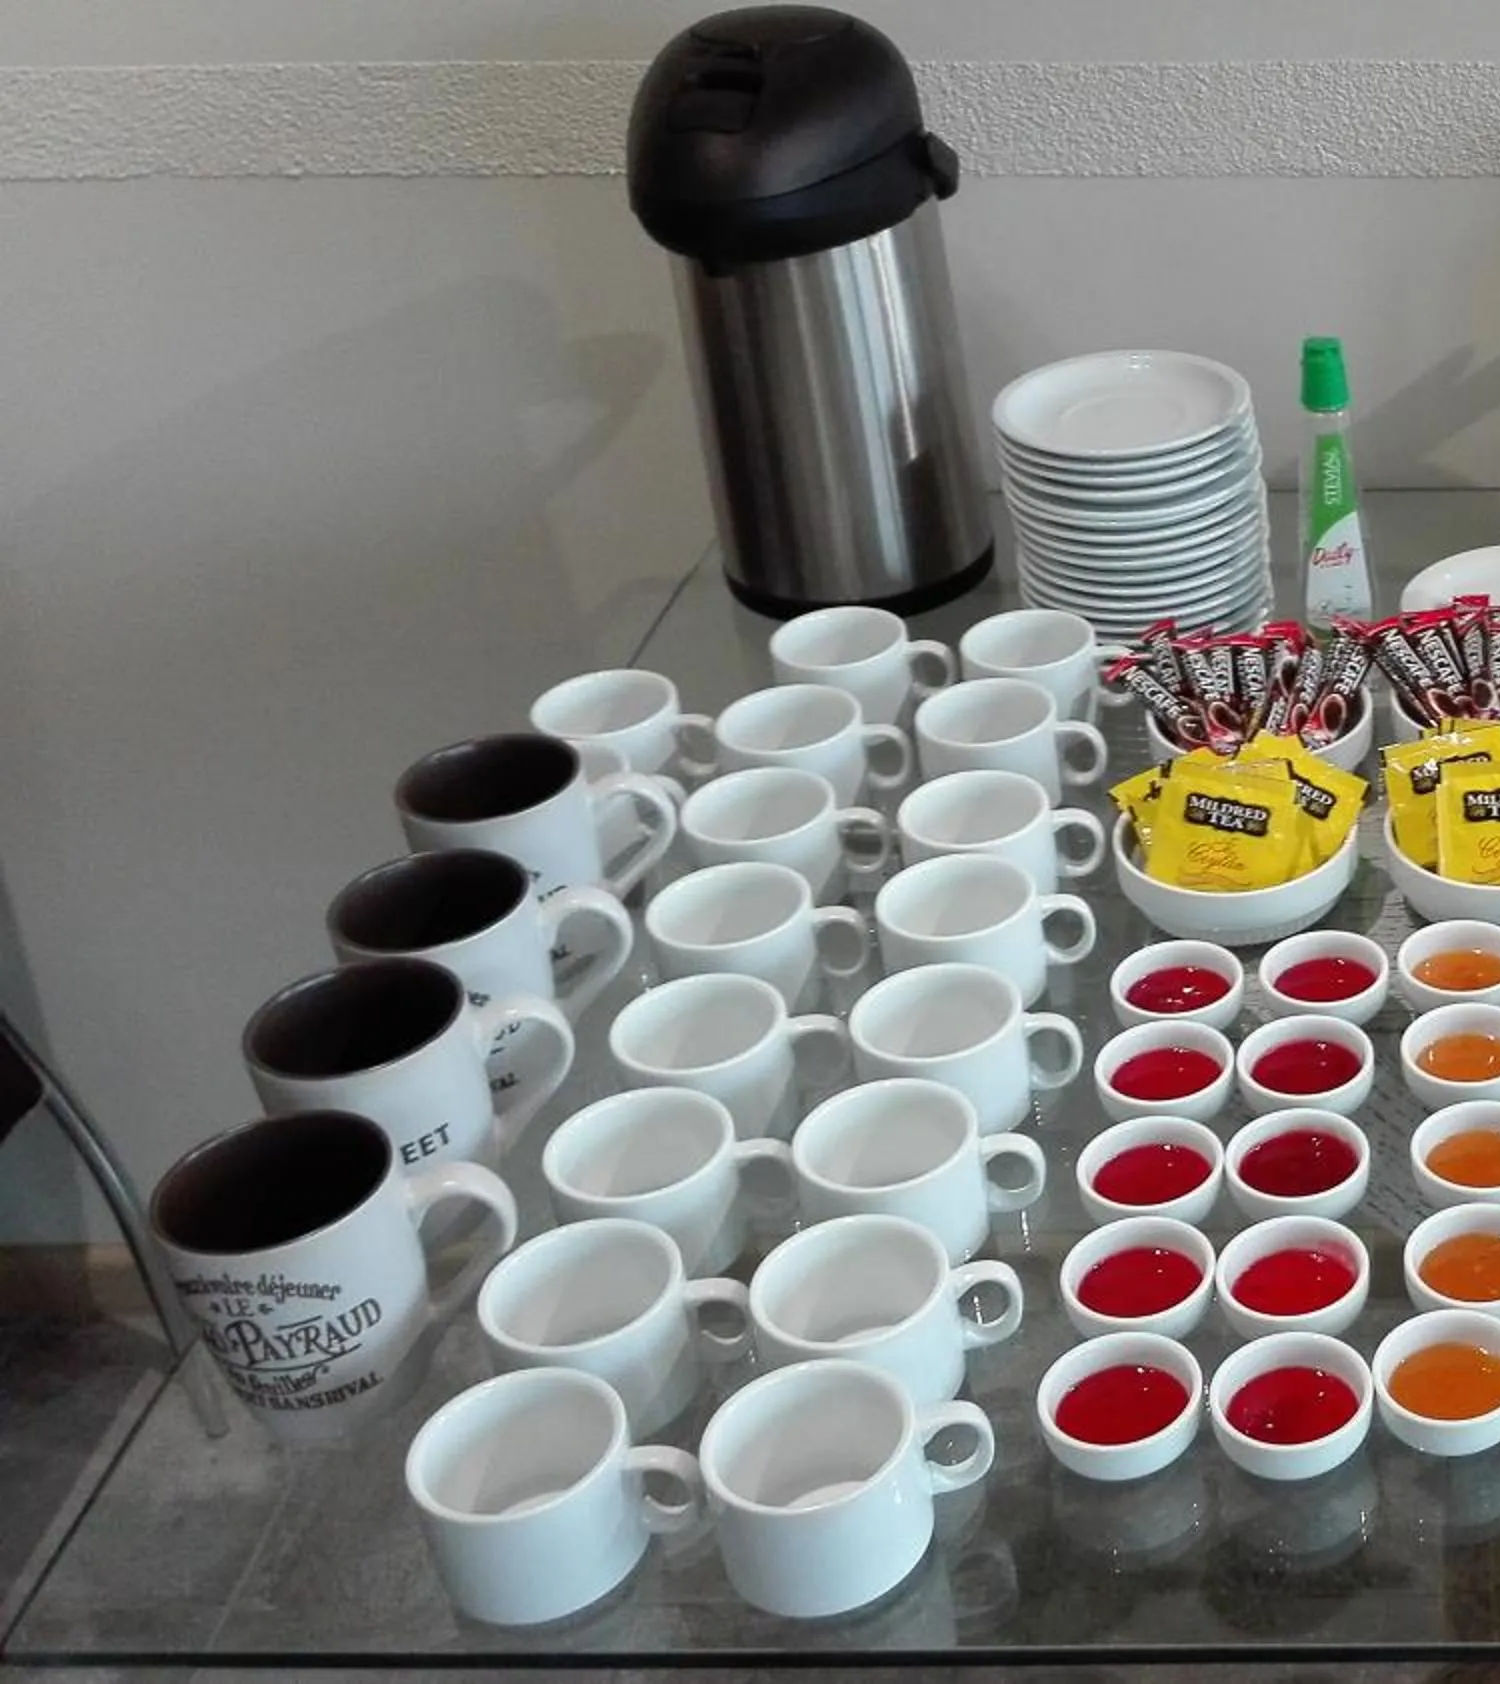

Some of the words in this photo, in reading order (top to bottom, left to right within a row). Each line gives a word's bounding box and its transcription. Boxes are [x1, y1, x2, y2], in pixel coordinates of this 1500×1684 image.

[1189, 795, 1267, 822] MILDRED
[1207, 812, 1244, 829] TEA
[400, 1122, 450, 1165] EET
